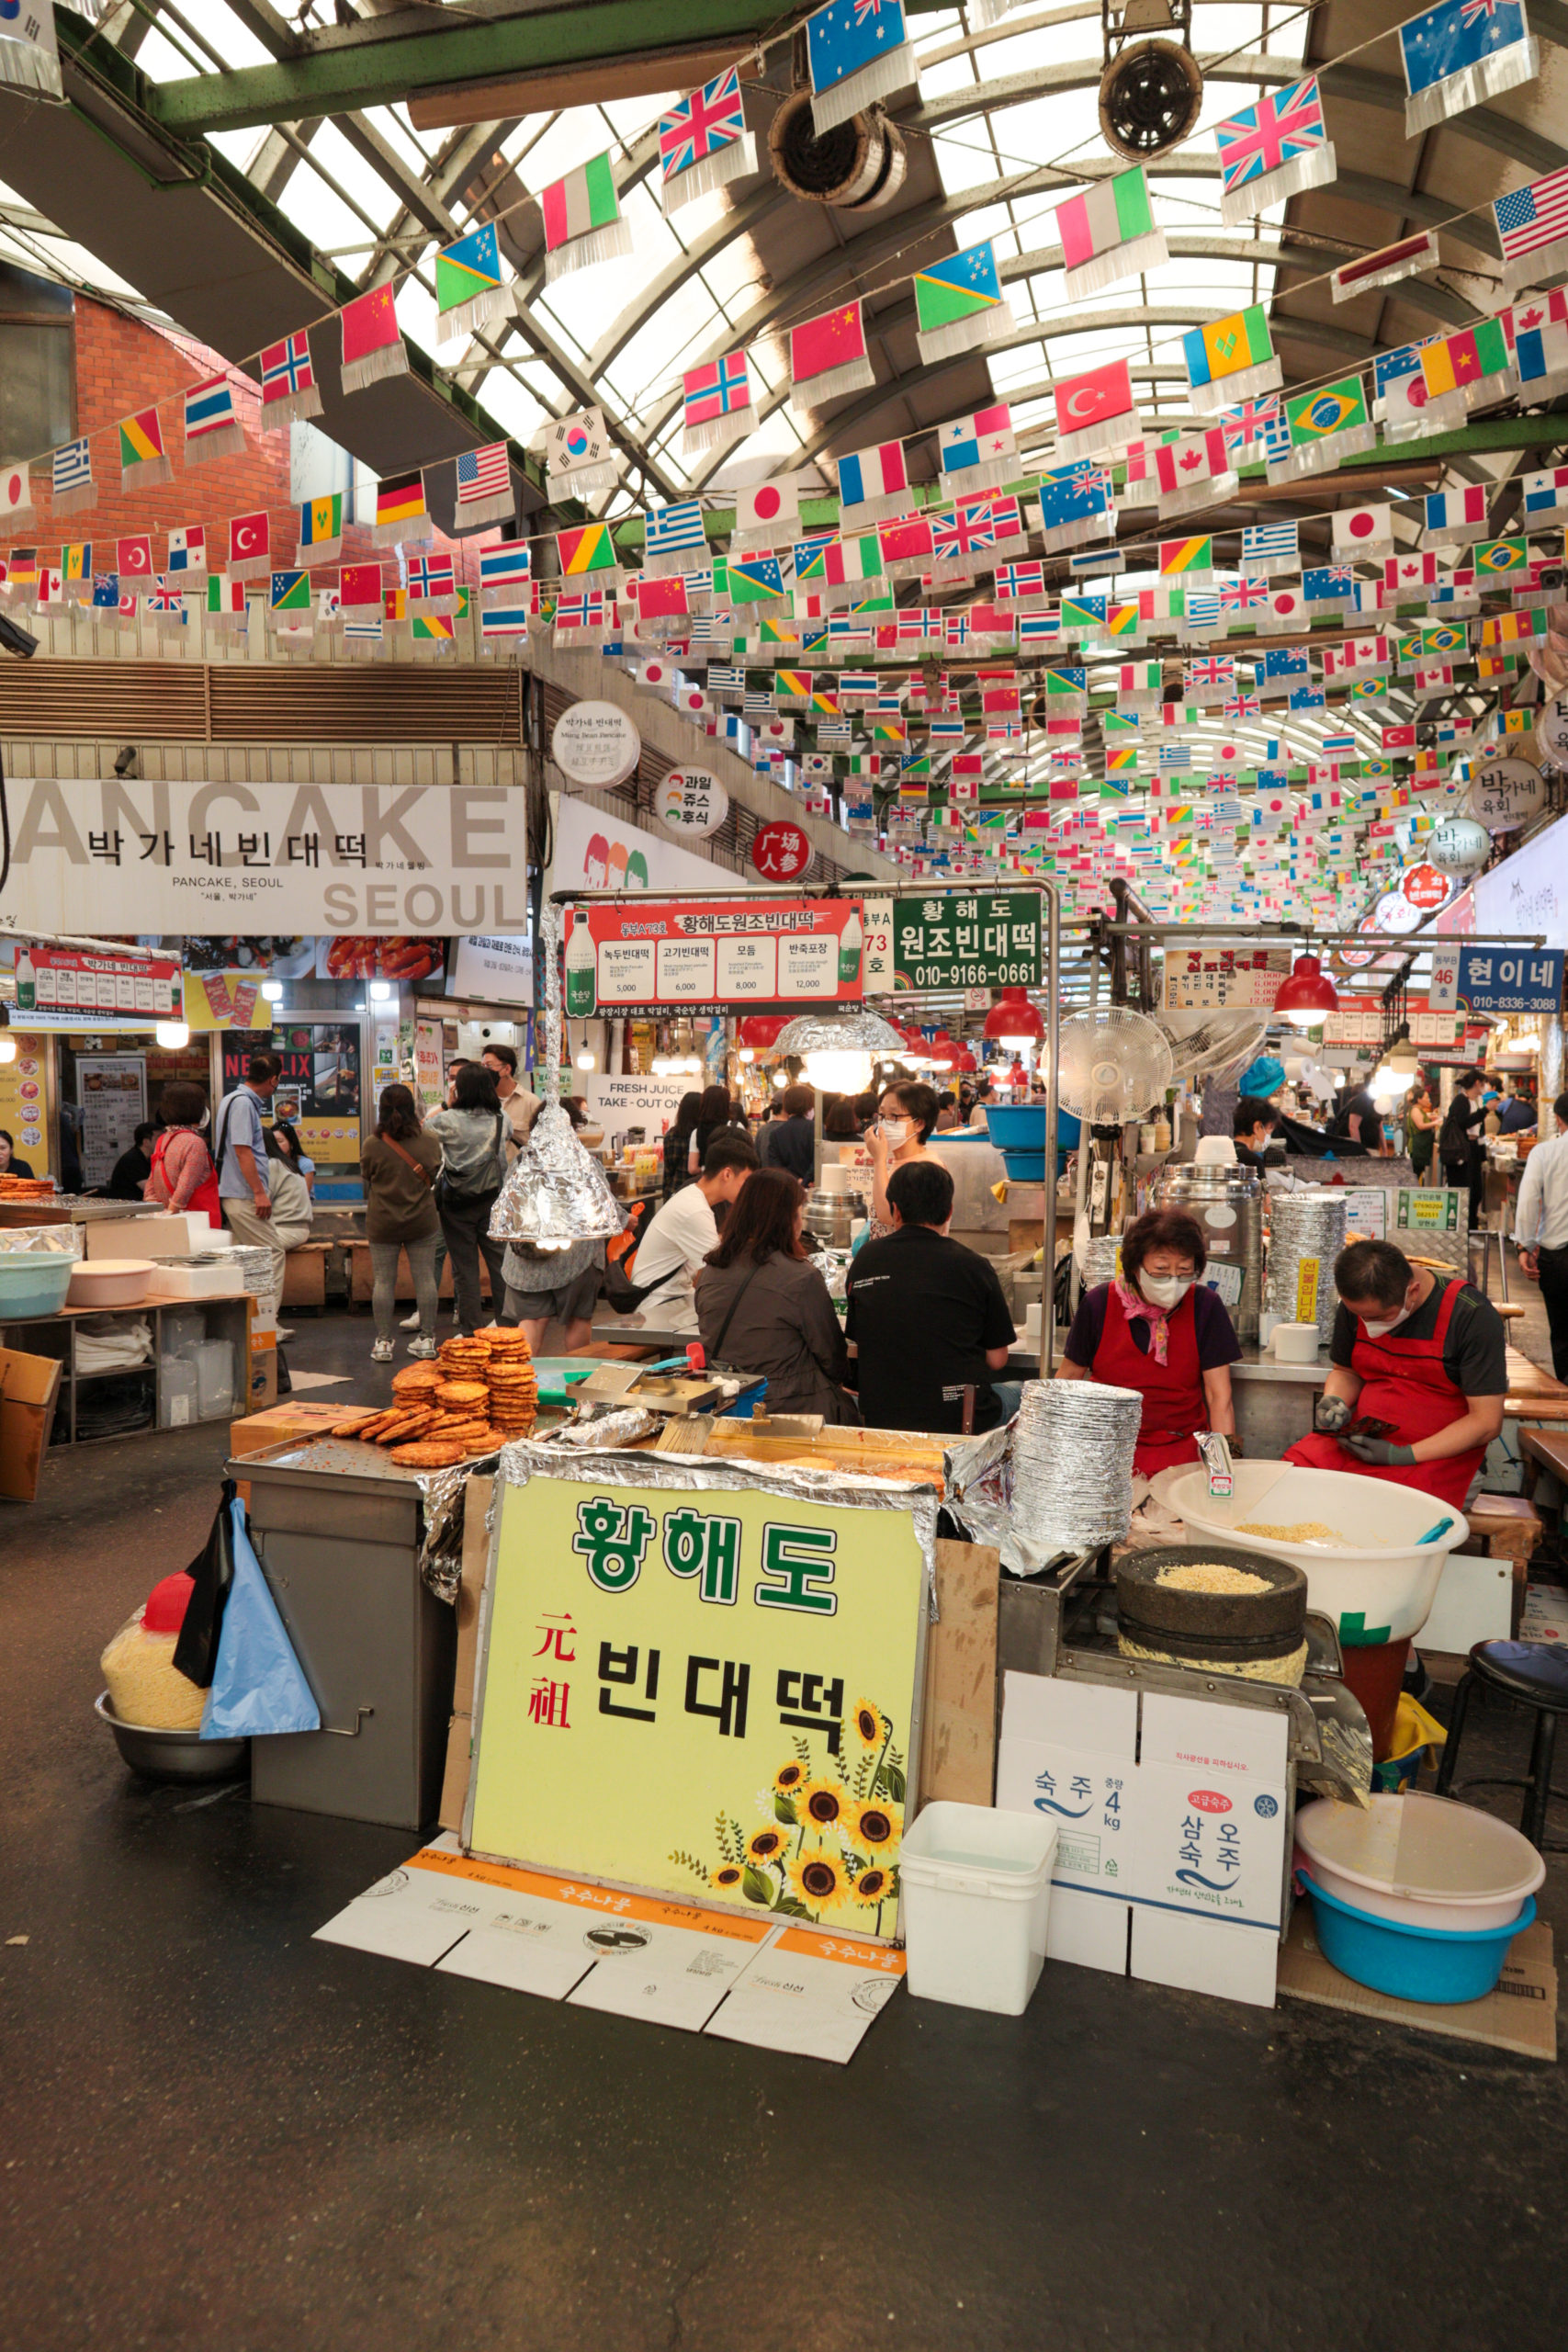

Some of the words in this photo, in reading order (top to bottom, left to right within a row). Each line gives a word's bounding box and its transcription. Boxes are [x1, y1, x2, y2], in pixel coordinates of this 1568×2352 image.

[566, 718, 592, 727] 박가네
[684, 775, 712, 789] 과일
[1481, 770, 1536, 798] 박가네
[683, 793, 710, 808] 쥬스
[1481, 797, 1510, 815] 육회
[682, 810, 709, 825] 후식
[761, 831, 801, 852] 广场
[1437, 829, 1482, 851] 박가네
[88, 830, 367, 869] 박가네빈대떡
[761, 854, 799, 872] 人参
[172, 876, 237, 889] PANCAKE,
[242, 877, 284, 888] SEOUL
[322, 882, 525, 928] SEOUL
[921, 899, 1012, 922] 황해도
[621, 922, 668, 937] 동부A73호
[682, 911, 815, 934] 황해도원조빈대떡
[789, 943, 828, 955] 반죽포장
[864, 934, 887, 952] 73
[899, 922, 1036, 960] 원조빈대떡
[604, 949, 649, 960] 녹두빈대떡
[663, 946, 709, 957] 고기빈대떡
[737, 945, 756, 956] 모듬
[88, 960, 116, 971] 박가네
[120, 962, 149, 975] 빈대떡
[868, 957, 886, 973] 호
[1436, 956, 1457, 966] 동부B
[915, 963, 1035, 986] 010-9166-0661
[1434, 969, 1453, 984] 46
[1468, 957, 1555, 989] 현이네
[616, 984, 637, 992] 5,000
[676, 983, 696, 991] 6,000
[736, 981, 756, 989] 8,000
[796, 979, 820, 989] 12,000
[1438, 988, 1449, 998] 호
[1472, 996, 1556, 1011] 010-8336-3088
[599, 1007, 628, 1017] 광장시장
[630, 1007, 645, 1016] 대표
[225, 1054, 311, 1078] NELIX
[610, 1082, 648, 1093] FRESH
[649, 1084, 684, 1095] JUICE
[598, 1097, 627, 1107] TAKE
[637, 1098, 661, 1109] OUT
[1300, 1262, 1316, 1318] 선불입니다
[572, 1497, 839, 1616] 황해도
[527, 1612, 578, 1729] 元祖
[597, 1640, 845, 1755] 빈대떡
[1212, 1758, 1249, 1771] 피하십시오.
[1034, 1770, 1092, 1800] 숙주
[1105, 1778, 1123, 1790] 중량
[1105, 1792, 1121, 1814] 4
[1190, 1793, 1230, 1810] 고급숙주
[1104, 1813, 1121, 1831] kg
[1180, 1815, 1241, 1845] 삼오
[1179, 1841, 1241, 1871] 숙주
[558, 1884, 632, 1913] 숙주나물
[818, 1940, 899, 1969] 숙주나물
[783, 1983, 805, 1993] 신선
